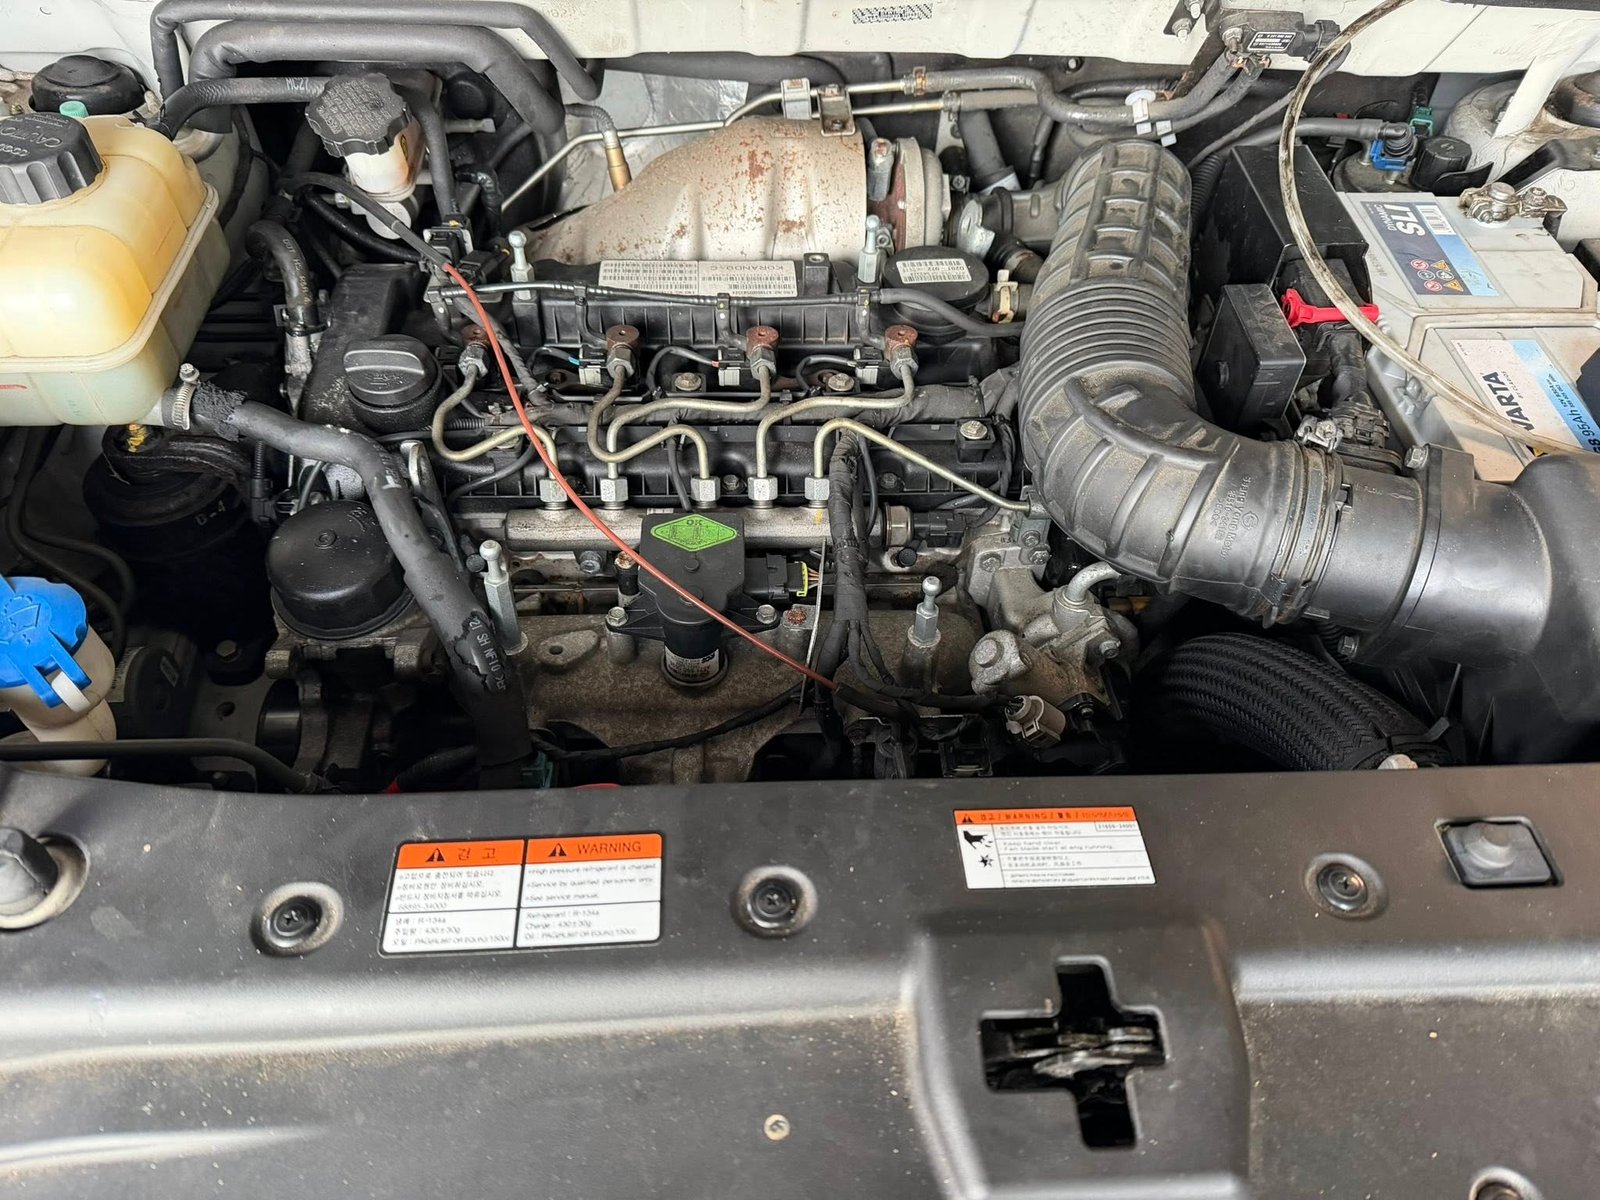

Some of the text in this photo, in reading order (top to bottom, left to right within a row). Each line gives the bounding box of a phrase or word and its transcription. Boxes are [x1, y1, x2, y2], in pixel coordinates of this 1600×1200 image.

[1373, 204, 1397, 232] DYNAMIC
[1384, 203, 1426, 237] SLI
[1482, 371, 1536, 431] VARTA
[1005, 811, 1047, 821] WARNING
[577, 841, 642, 854] WARNING
[583, 864, 619, 873] refrigerant
